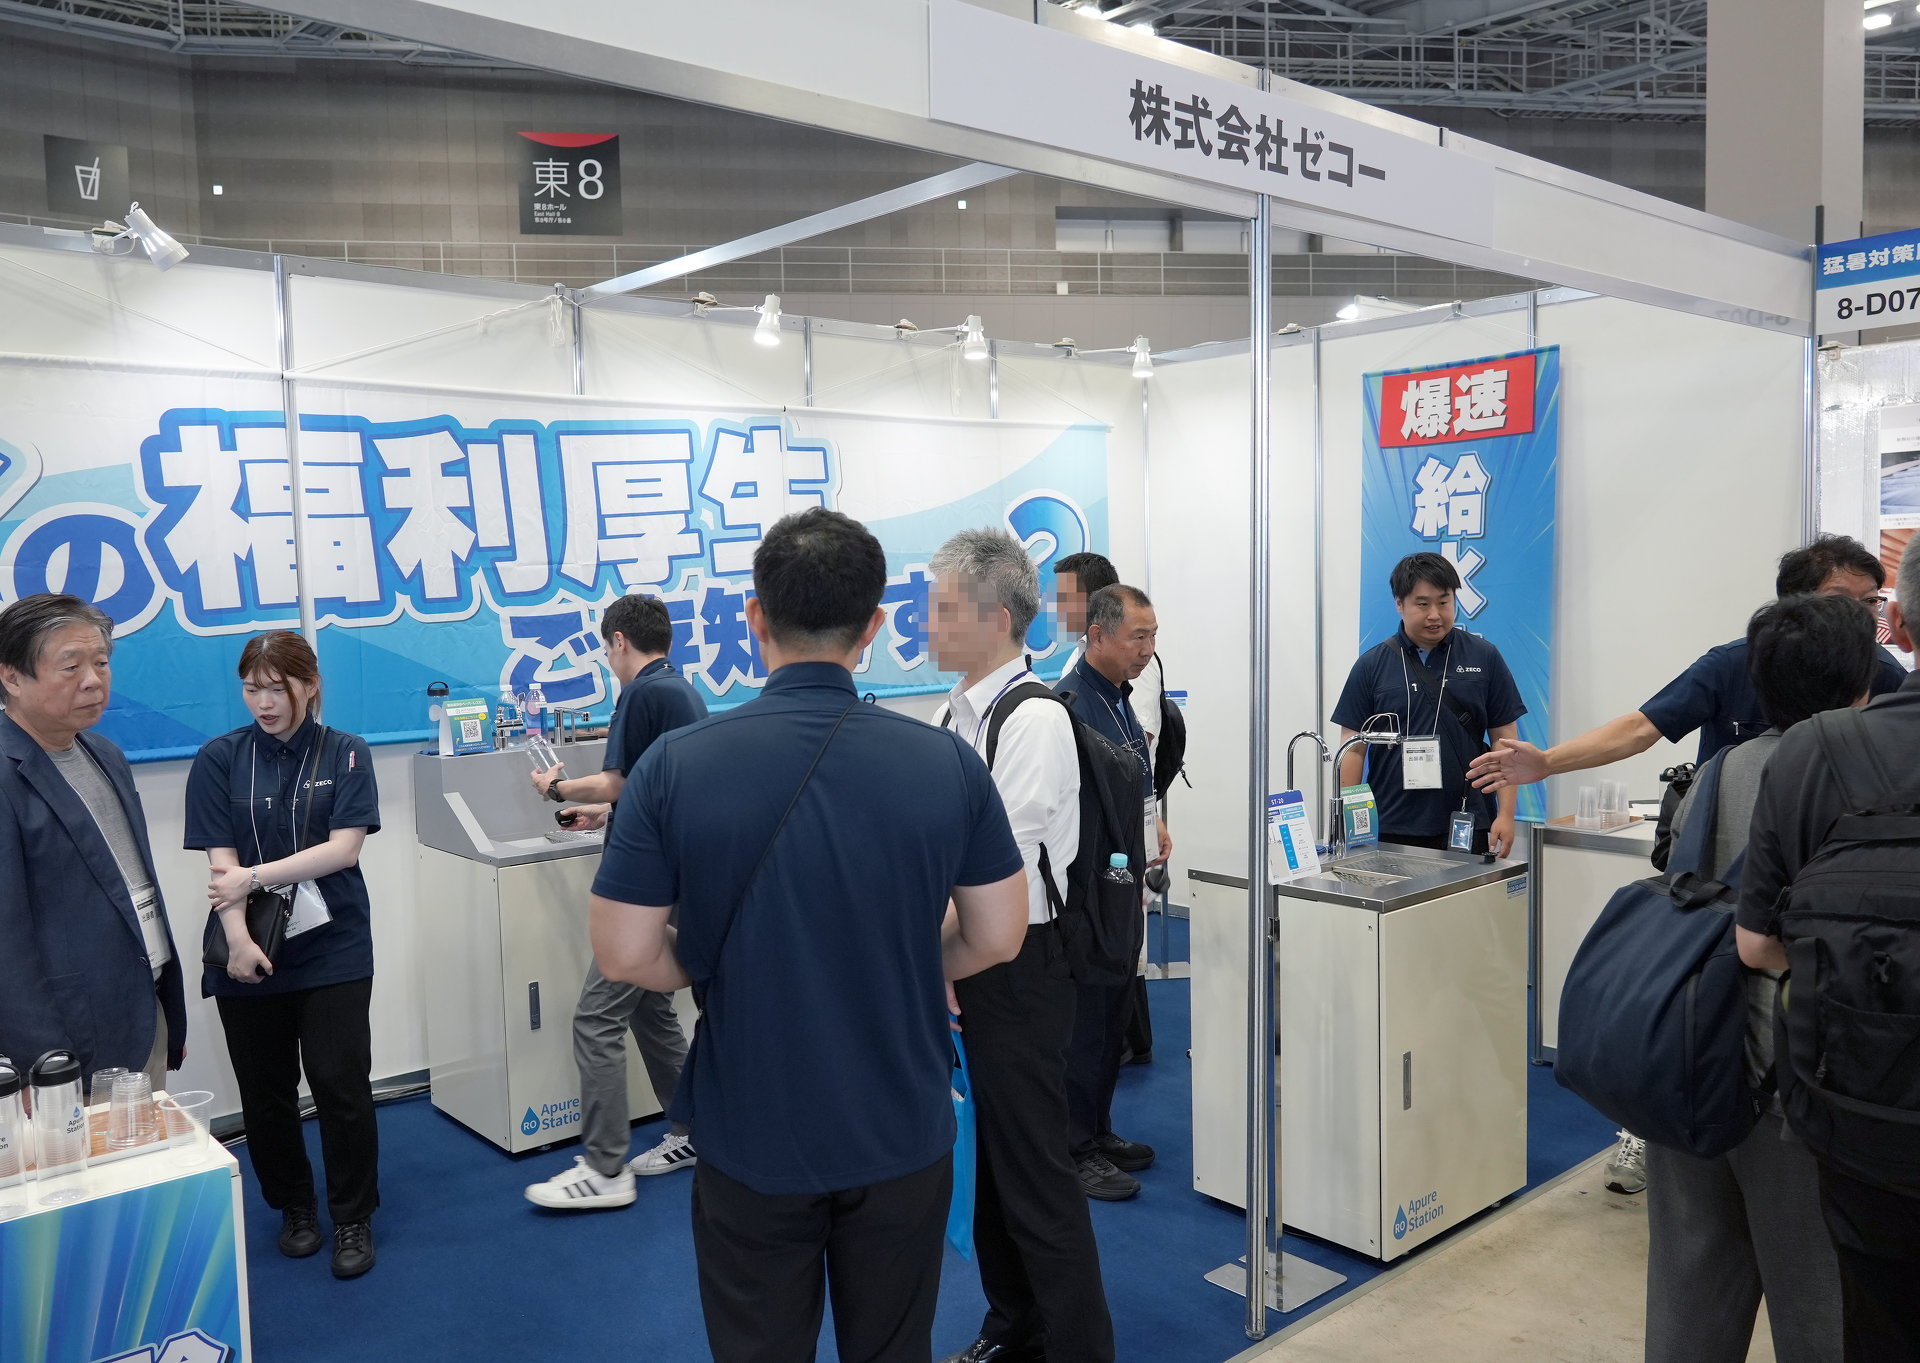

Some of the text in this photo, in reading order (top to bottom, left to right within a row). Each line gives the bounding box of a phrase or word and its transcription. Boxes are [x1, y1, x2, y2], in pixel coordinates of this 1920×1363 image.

[1128, 78, 1386, 188] 株式会社ゼコー
[1823, 242, 1920, 276] 猛暑対策
[1837, 287, 1920, 320] 8-D07
[1400, 368, 1509, 441] 爆速
[0, 424, 828, 628] の福利厚生
[1411, 451, 1488, 640] 給水
[540, 1097, 580, 1117] Apure
[541, 1110, 581, 1131] Statio
[523, 1120, 537, 1131] RO
[1408, 1190, 1438, 1216] Apure
[1408, 1204, 1444, 1232] Station
[1395, 1220, 1406, 1235] RO
